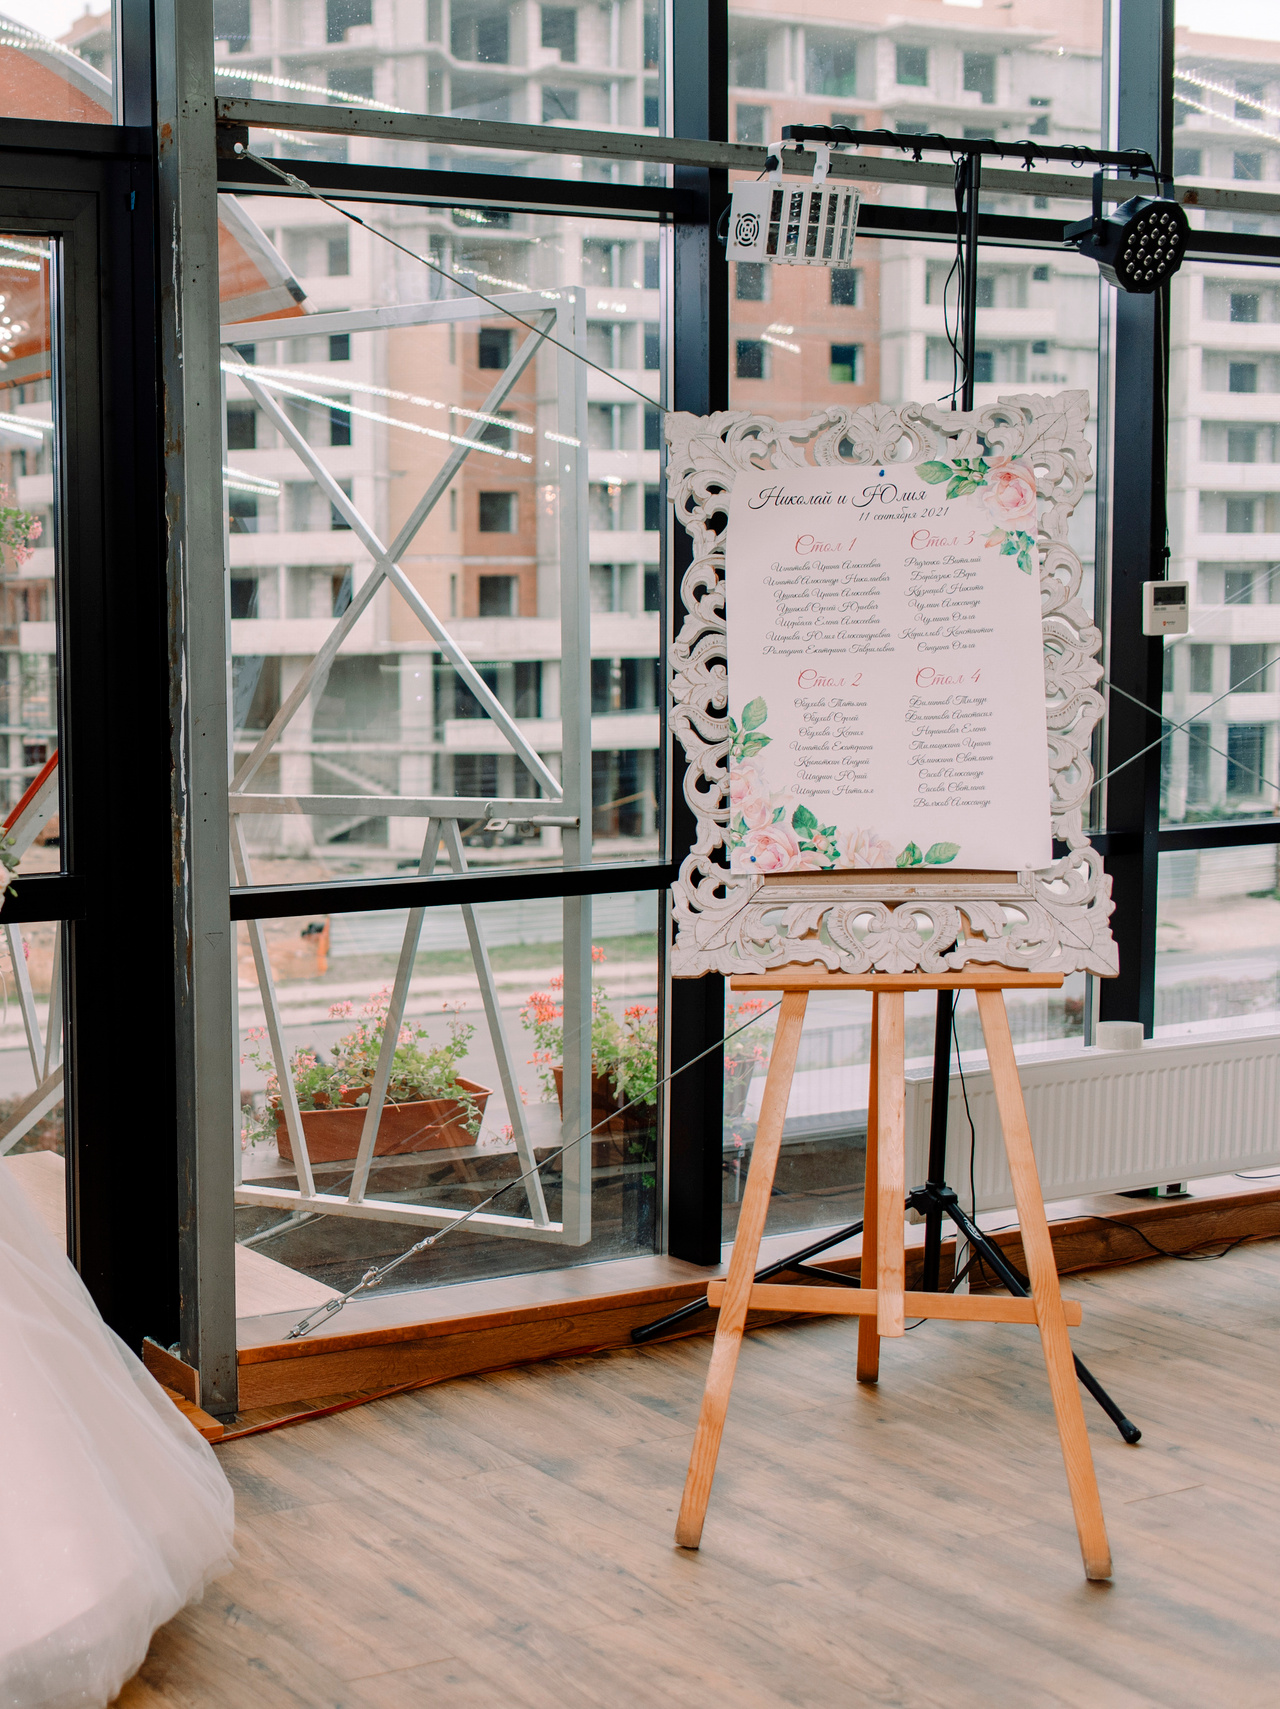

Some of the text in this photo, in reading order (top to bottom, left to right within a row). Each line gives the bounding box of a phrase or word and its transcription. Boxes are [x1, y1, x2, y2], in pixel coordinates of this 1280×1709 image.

[748, 483, 927, 509] Николай и Юлия
[858, 506, 950, 523] 11 сентября 2021
[795, 534, 858, 555] Стол 1
[910, 529, 976, 551] Стол 3
[771, 558, 881, 572] Игнатова Ирина Алексеевна
[904, 555, 981, 569] Радченко Виталий
[763, 572, 890, 586] Игнатов Александр Николаевич
[953, 568, 977, 580] Вера
[811, 588, 839, 600] Ирина
[841, 586, 881, 597] Алексеевна
[904, 582, 984, 597] Кузнецов Никита
[811, 602, 836, 613] Сергей
[838, 600, 879, 613] Юрьевич
[941, 598, 981, 608] Александр
[814, 616, 839, 626] Елена
[841, 614, 880, 626] Алексеевна
[952, 611, 976, 622] Ольга
[802, 630, 836, 642] Юлия
[837, 628, 891, 641] Александровна
[898, 625, 994, 640] Кириллов Константин
[805, 645, 846, 655] Екатерина
[848, 642, 895, 655] Гавриловна
[951, 640, 976, 651] Ольга
[797, 668, 863, 690] Стол 2
[915, 667, 981, 688] Стол 4
[794, 697, 867, 710] Обухова Татьяна
[909, 695, 987, 709] Филиппов Тимур
[803, 712, 859, 725] Обухов Сергей
[905, 709, 993, 723] Филиппова Анастасия
[798, 726, 864, 739] Обухова Ксения
[961, 723, 987, 734] Елена
[789, 740, 873, 753] Игнатова Екатерина
[962, 737, 991, 749] Ирина
[793, 755, 870, 768] Кропоткин Андрей
[955, 752, 994, 763] Светлана
[834, 769, 867, 782] Юрий
[944, 767, 984, 779] Александр
[832, 784, 874, 796] Наталья
[947, 781, 985, 793] Светлана
[951, 797, 991, 808] Александр
